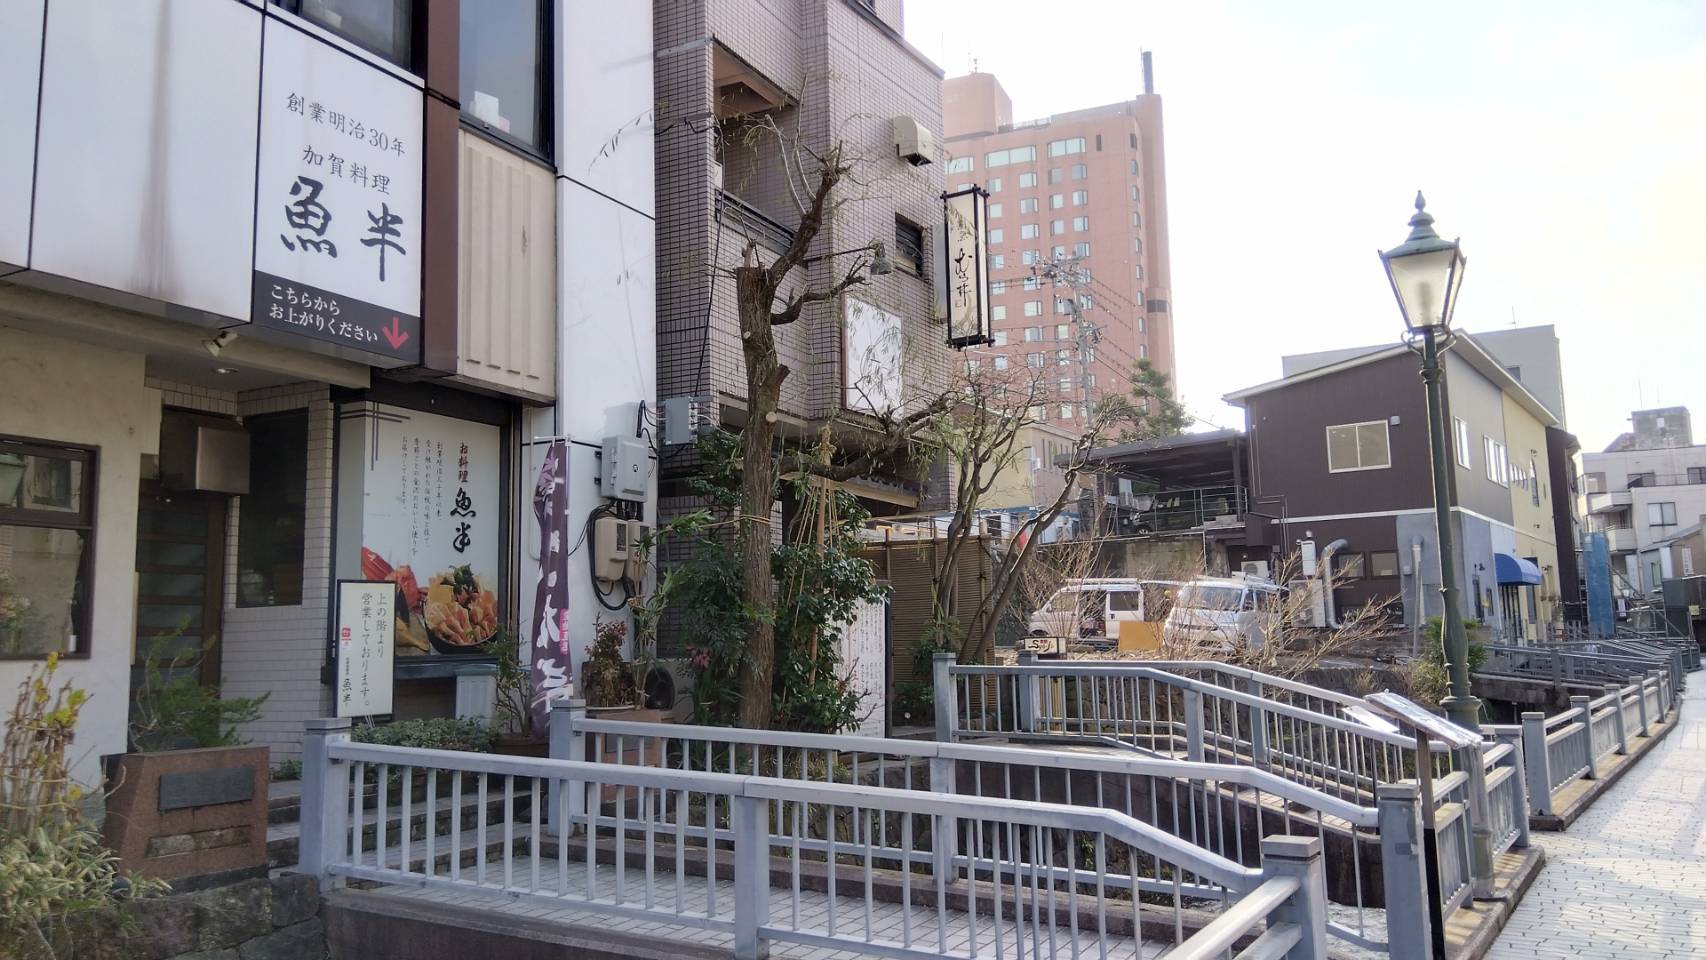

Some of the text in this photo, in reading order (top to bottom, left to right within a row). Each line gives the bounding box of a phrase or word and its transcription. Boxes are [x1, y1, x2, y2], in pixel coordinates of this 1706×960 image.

[286, 92, 406, 158] 創業明治30年
[302, 144, 390, 196] 加賀料理
[280, 175, 407, 282] 魚半
[269, 303, 378, 343] お上がりください
[271, 284, 341, 316] こちらから
[458, 441, 470, 484] お料理
[360, 592, 372, 706] 営業しております。
[376, 592, 388, 658] 上の階より
